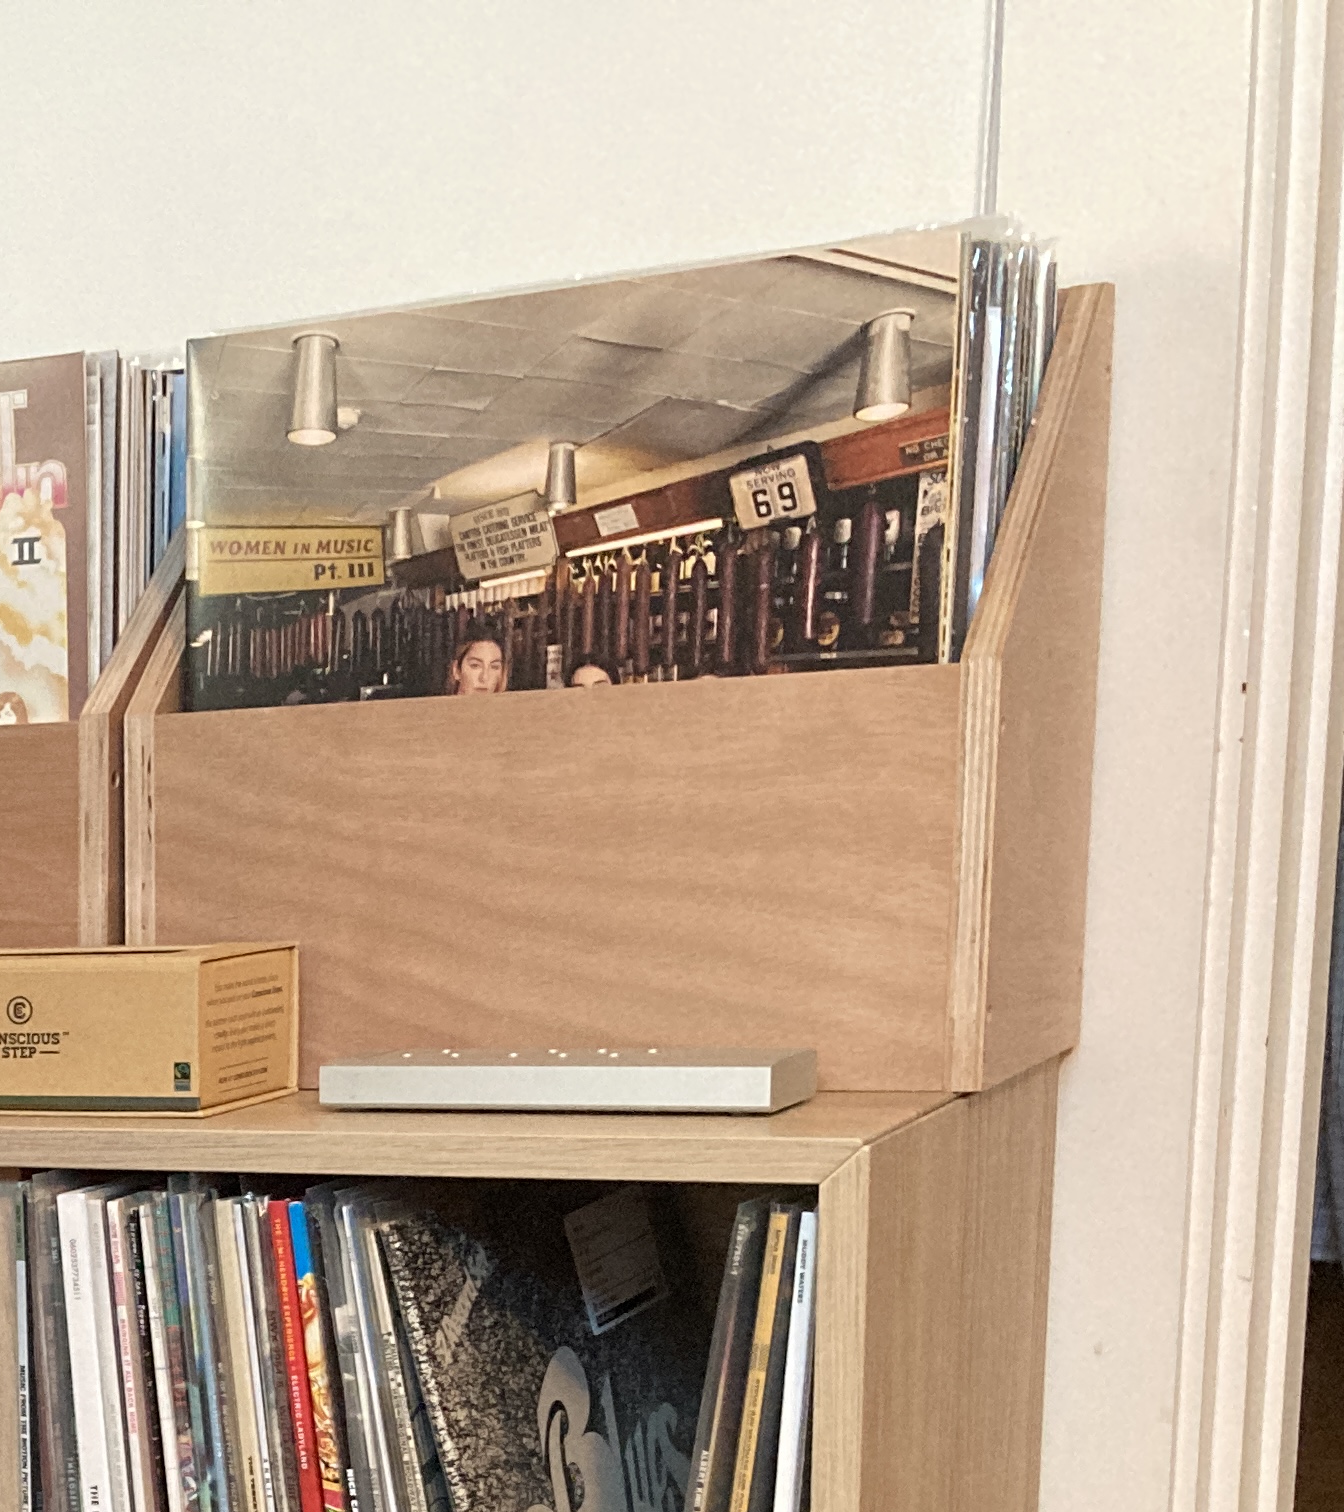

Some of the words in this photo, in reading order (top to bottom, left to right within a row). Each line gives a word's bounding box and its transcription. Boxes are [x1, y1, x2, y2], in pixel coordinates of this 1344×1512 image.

[752, 482, 797, 518] 69
[11, 536, 42, 566] II
[210, 536, 288, 558] WOMEN
[292, 540, 312, 557] IN
[316, 534, 375, 556] MUSIC
[2, 1047, 37, 1059] STEP
[296, 1421, 308, 1469] LADYLAND
[346, 1468, 357, 1496] NICK
